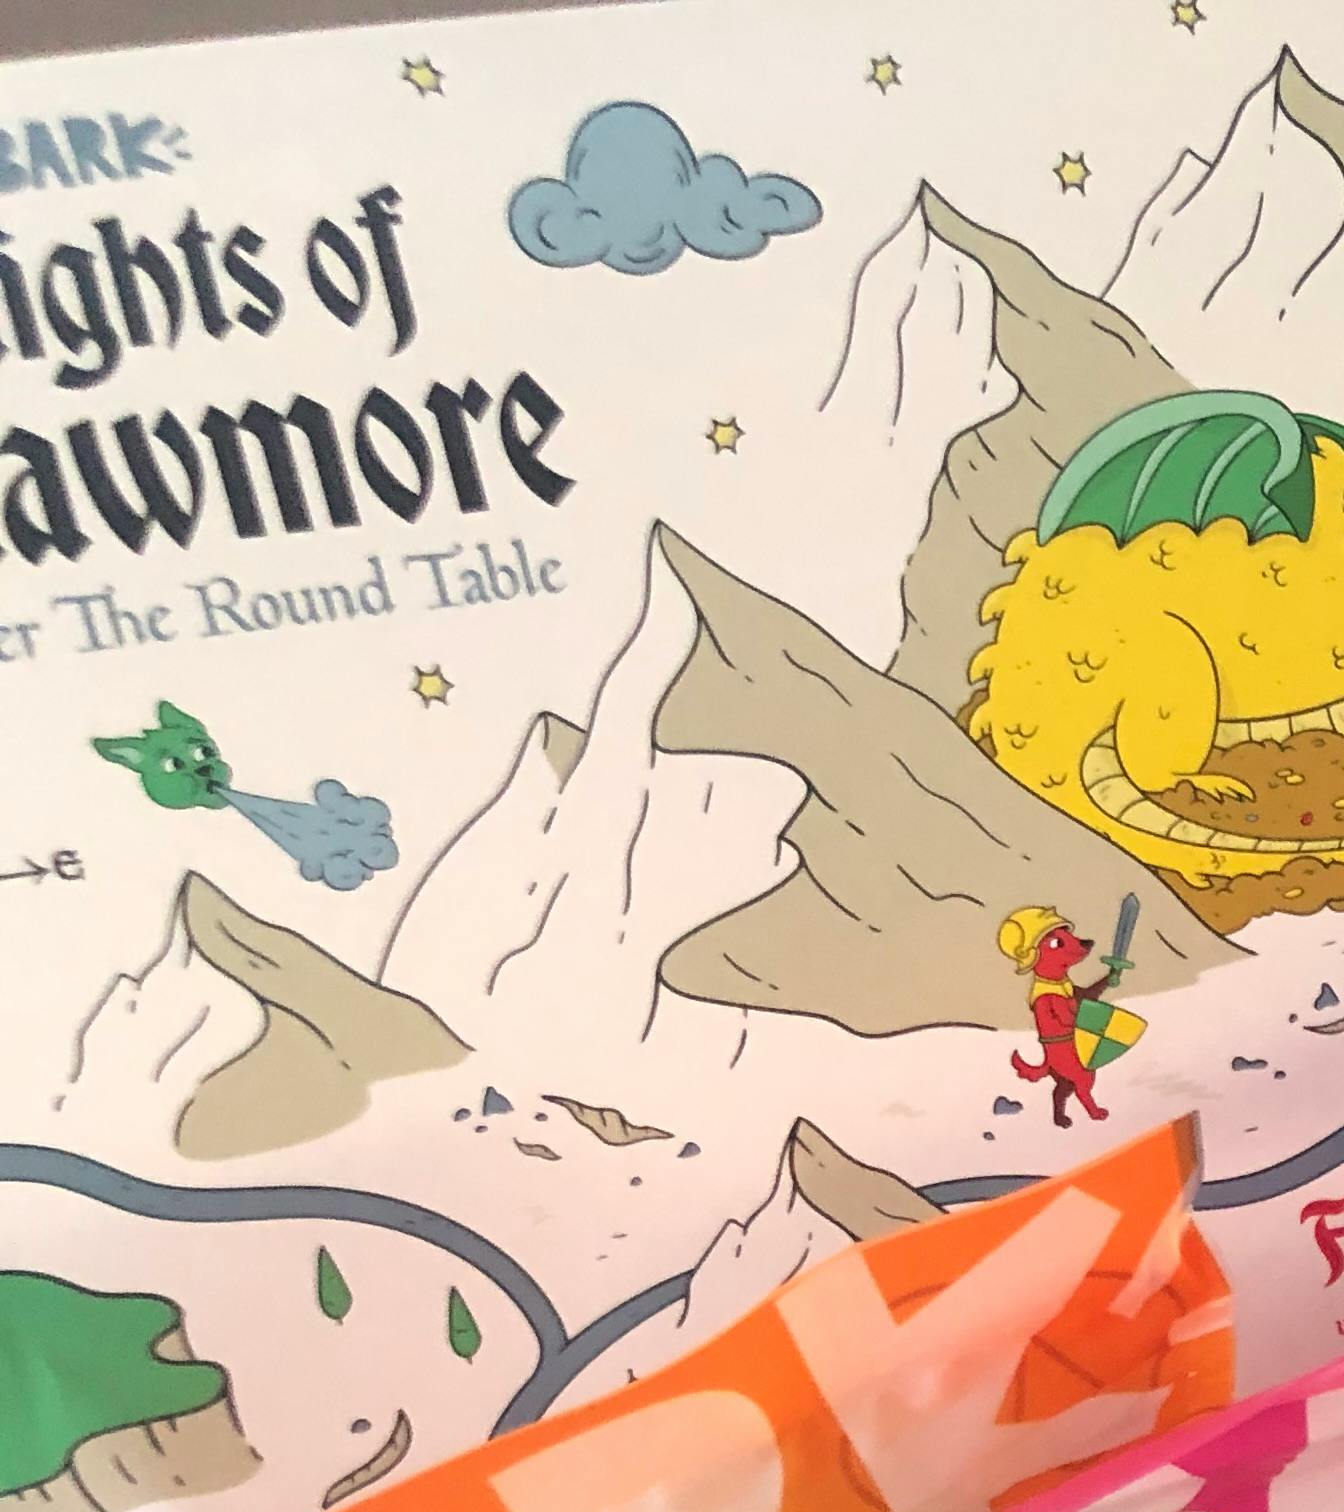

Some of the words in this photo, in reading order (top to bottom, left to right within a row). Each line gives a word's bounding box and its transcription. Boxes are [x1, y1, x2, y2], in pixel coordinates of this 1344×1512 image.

[0, 208, 286, 391] ights
[306, 184, 418, 359] of
[0, 371, 578, 567] awmore
[52, 586, 178, 653] The
[186, 554, 396, 638] Round
[404, 538, 568, 610] Table
